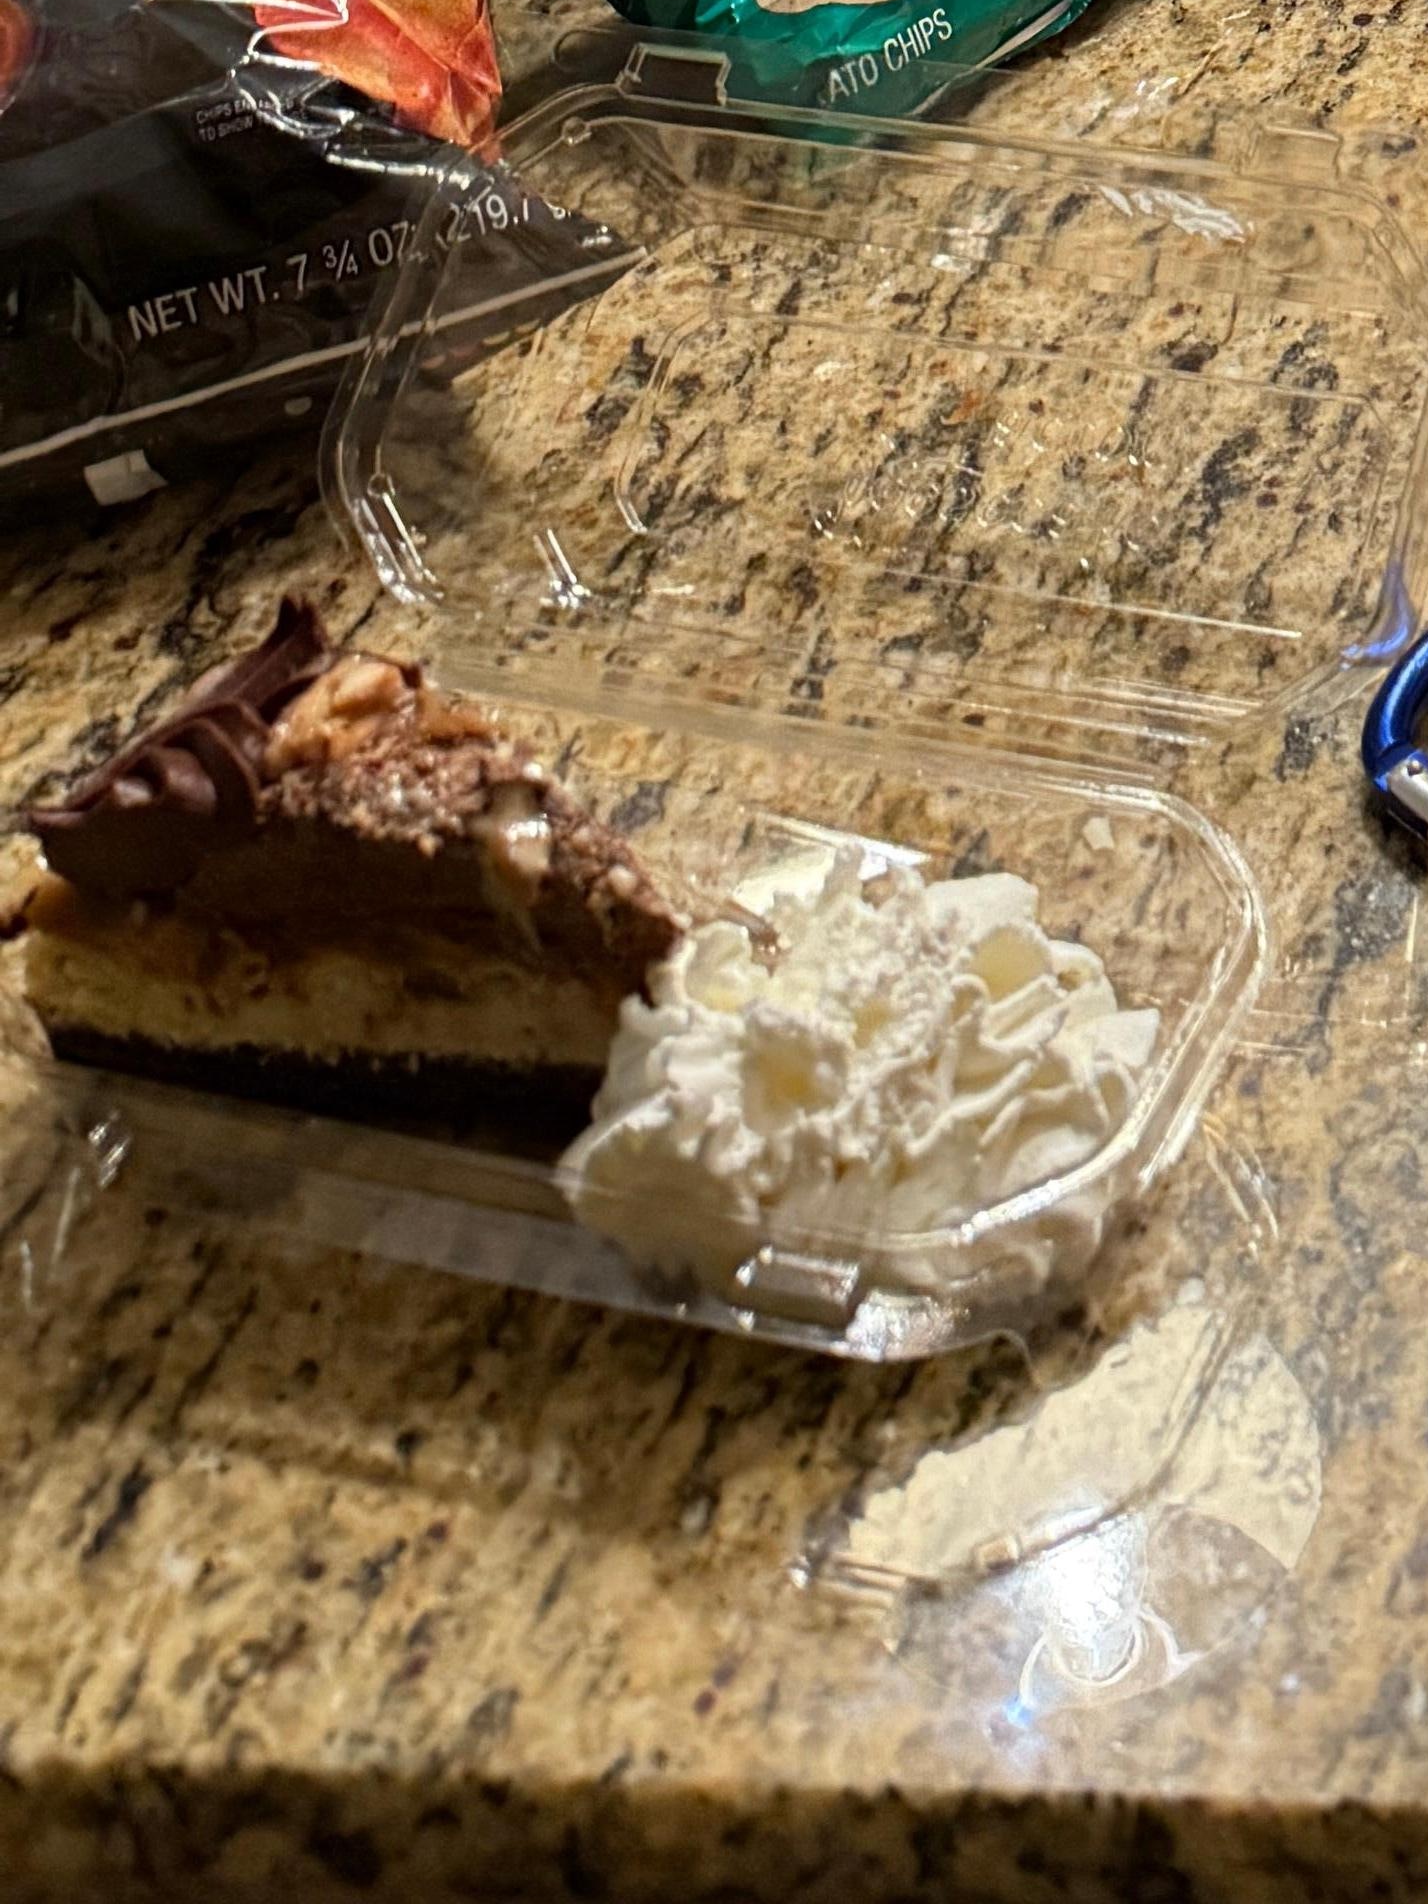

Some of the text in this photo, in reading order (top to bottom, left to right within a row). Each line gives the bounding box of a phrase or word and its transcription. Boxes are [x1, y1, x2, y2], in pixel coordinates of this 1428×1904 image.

[827, 8, 953, 103] ATO CHIPS
[127, 288, 198, 342] NET
[209, 265, 281, 315] WT.
[287, 254, 308, 290] 7
